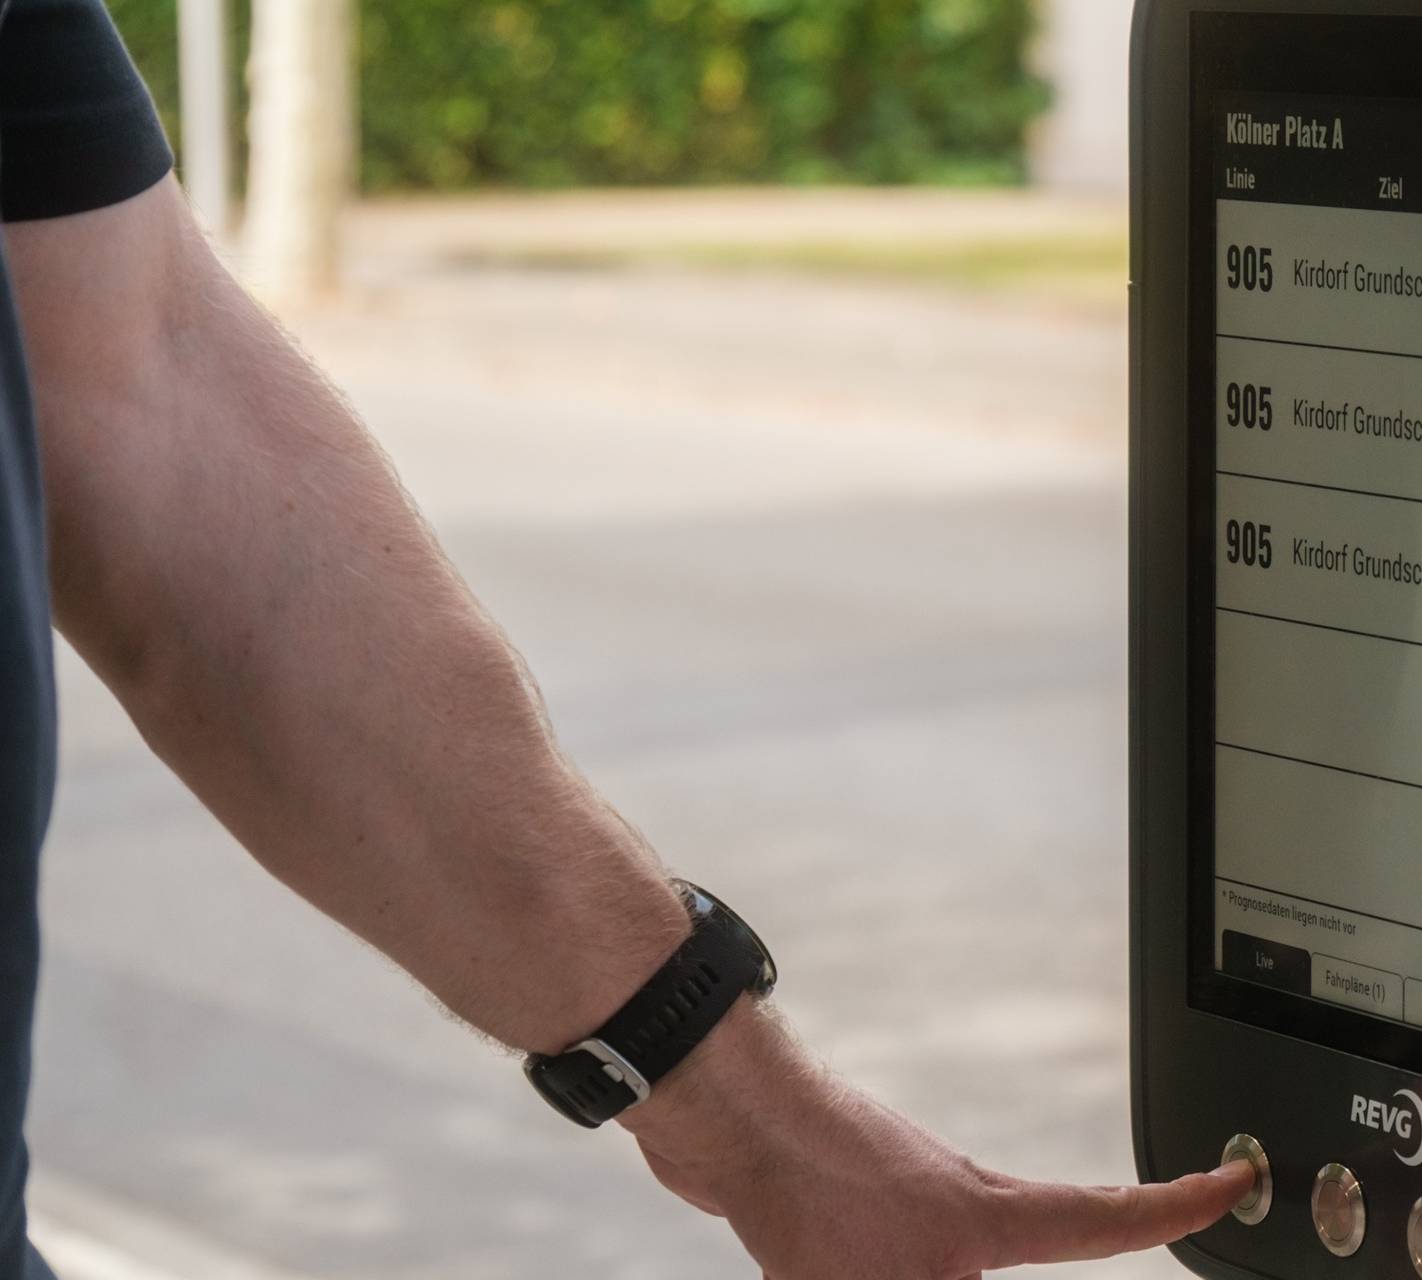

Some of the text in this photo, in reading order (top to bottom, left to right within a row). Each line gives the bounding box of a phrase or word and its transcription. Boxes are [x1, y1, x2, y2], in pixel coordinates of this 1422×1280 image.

[1226, 112, 1344, 150] Kölner Platz A
[1226, 168, 1256, 189] Linie
[1379, 177, 1403, 199] Ziel
[1227, 244, 1273, 292] 905
[1294, 258, 1350, 290] Kirdorf
[1227, 382, 1272, 431] 905
[1293, 399, 1348, 432] Kirdorf
[1226, 519, 1272, 569] 905
[1293, 537, 1348, 573] Kirdorf
[1228, 890, 1291, 920] Prognosedaten
[1291, 906, 1317, 928] liegen
[1319, 914, 1341, 933] nicht
[1342, 922, 1356, 937] vor
[1256, 951, 1274, 971] Live
[1325, 969, 1385, 1003] Fahrpläne (1)
[1350, 1094, 1412, 1139] REVG
